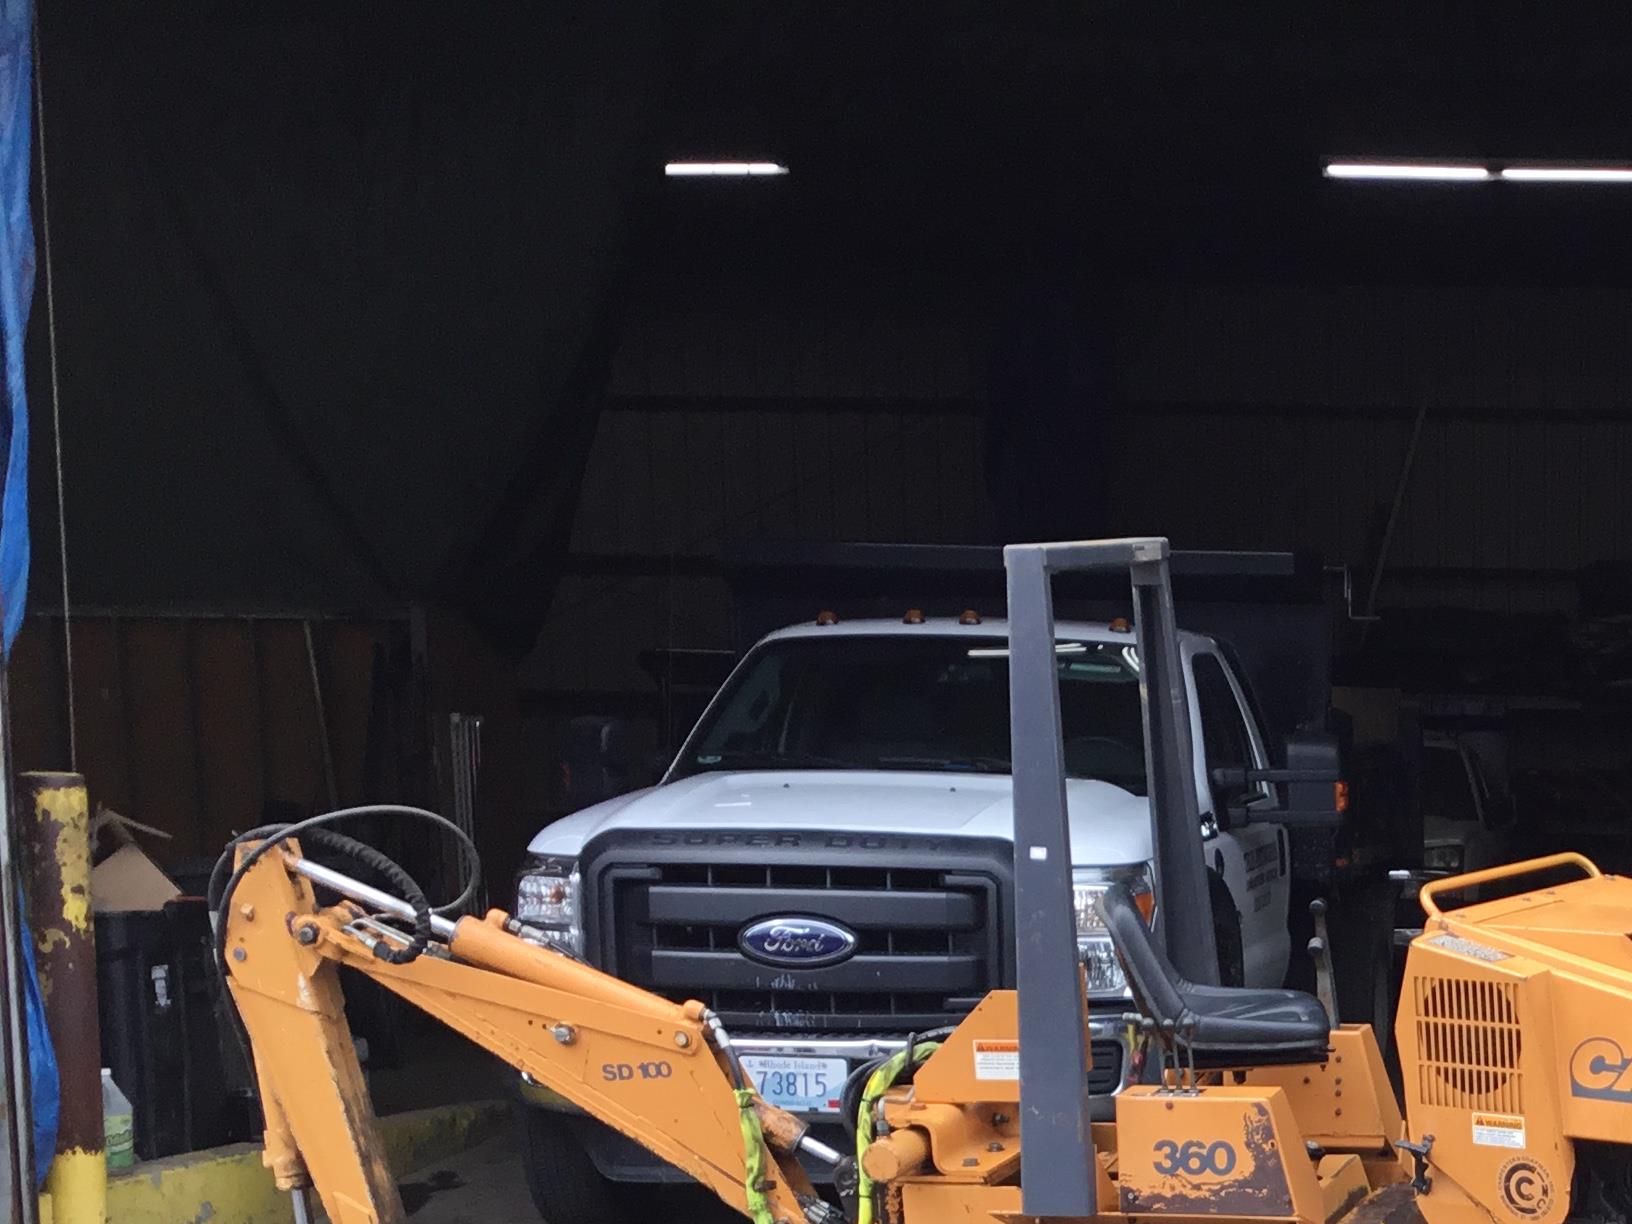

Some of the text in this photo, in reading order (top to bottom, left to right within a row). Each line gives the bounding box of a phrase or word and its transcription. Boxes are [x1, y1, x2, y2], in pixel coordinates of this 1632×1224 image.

[764, 926, 825, 952] Ford
[602, 1060, 673, 1081] SD 100
[765, 1060, 822, 1070] Rhode Island
[756, 1070, 827, 1098] 73815
[1153, 1139, 1237, 1176] 360
